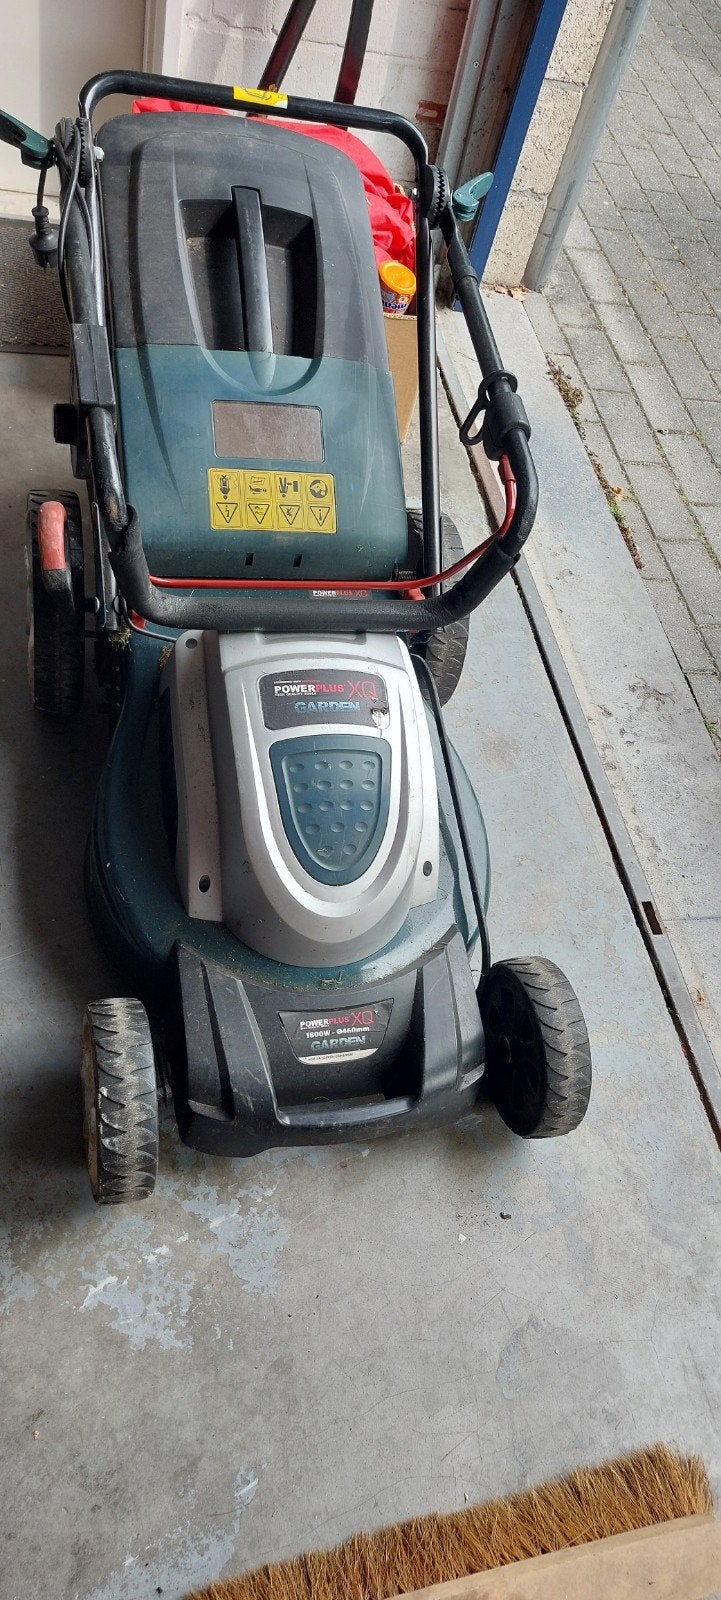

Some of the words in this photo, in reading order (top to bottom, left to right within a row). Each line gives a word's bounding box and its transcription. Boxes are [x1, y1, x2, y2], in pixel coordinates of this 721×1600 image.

[274, 684, 345, 694] POWERPLUS
[347, 680, 377, 699] XQ
[294, 701, 360, 713] GARDEN
[300, 1016, 350, 1028] POWERPLUS
[351, 1010, 375, 1026] XQ
[305, 1029, 331, 1039] 1800W
[310, 1035, 366, 1051] GARDEN
